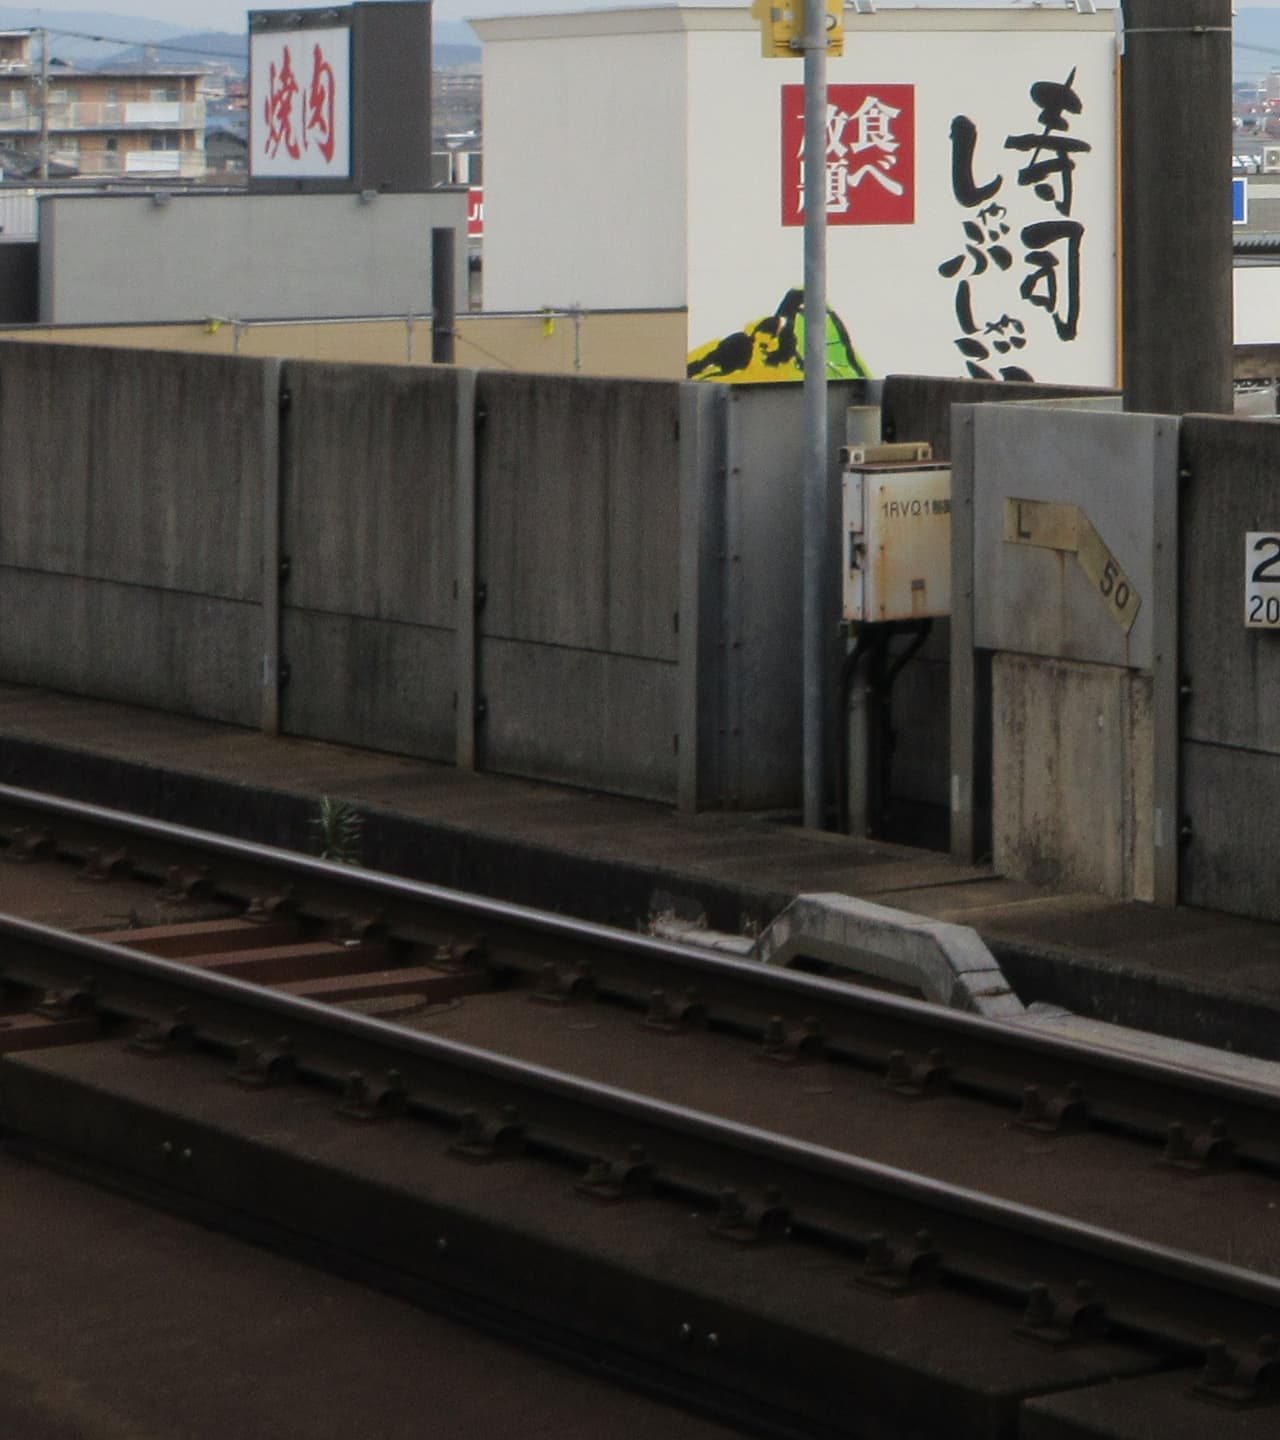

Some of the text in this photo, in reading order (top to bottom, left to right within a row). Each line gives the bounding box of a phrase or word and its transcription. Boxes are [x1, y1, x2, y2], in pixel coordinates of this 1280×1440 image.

[264, 43, 335, 164] 焼肉
[847, 96, 904, 197] 食べ
[1003, 65, 1092, 342] 寿司
[1017, 503, 1032, 539] L
[1100, 560, 1131, 610] 50
